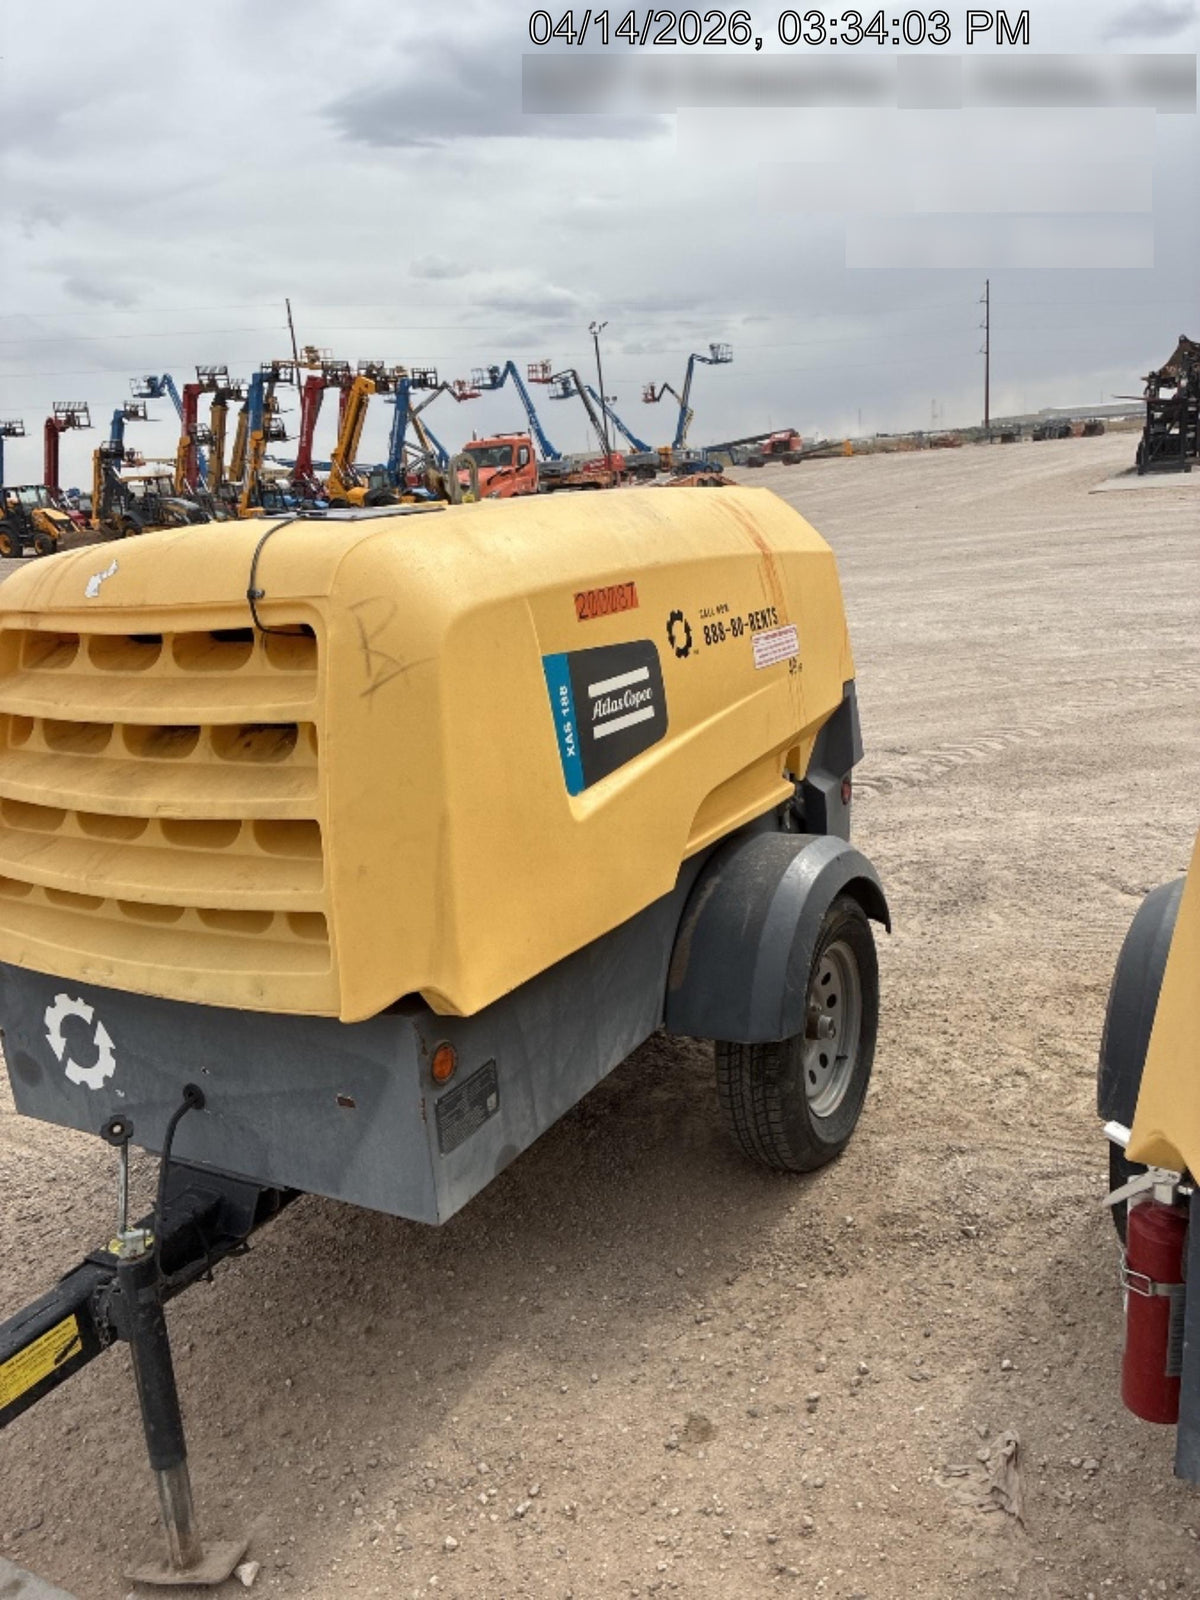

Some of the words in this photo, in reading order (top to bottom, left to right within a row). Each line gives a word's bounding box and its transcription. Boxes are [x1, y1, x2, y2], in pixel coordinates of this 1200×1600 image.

[575, 581, 636, 620] 200087
[703, 606, 778, 646] 888-80-RENTS
[560, 685, 570, 717] 188
[592, 697, 623, 721] Atlas
[623, 688, 653, 708] Copco
[563, 721, 575, 758] XAS
